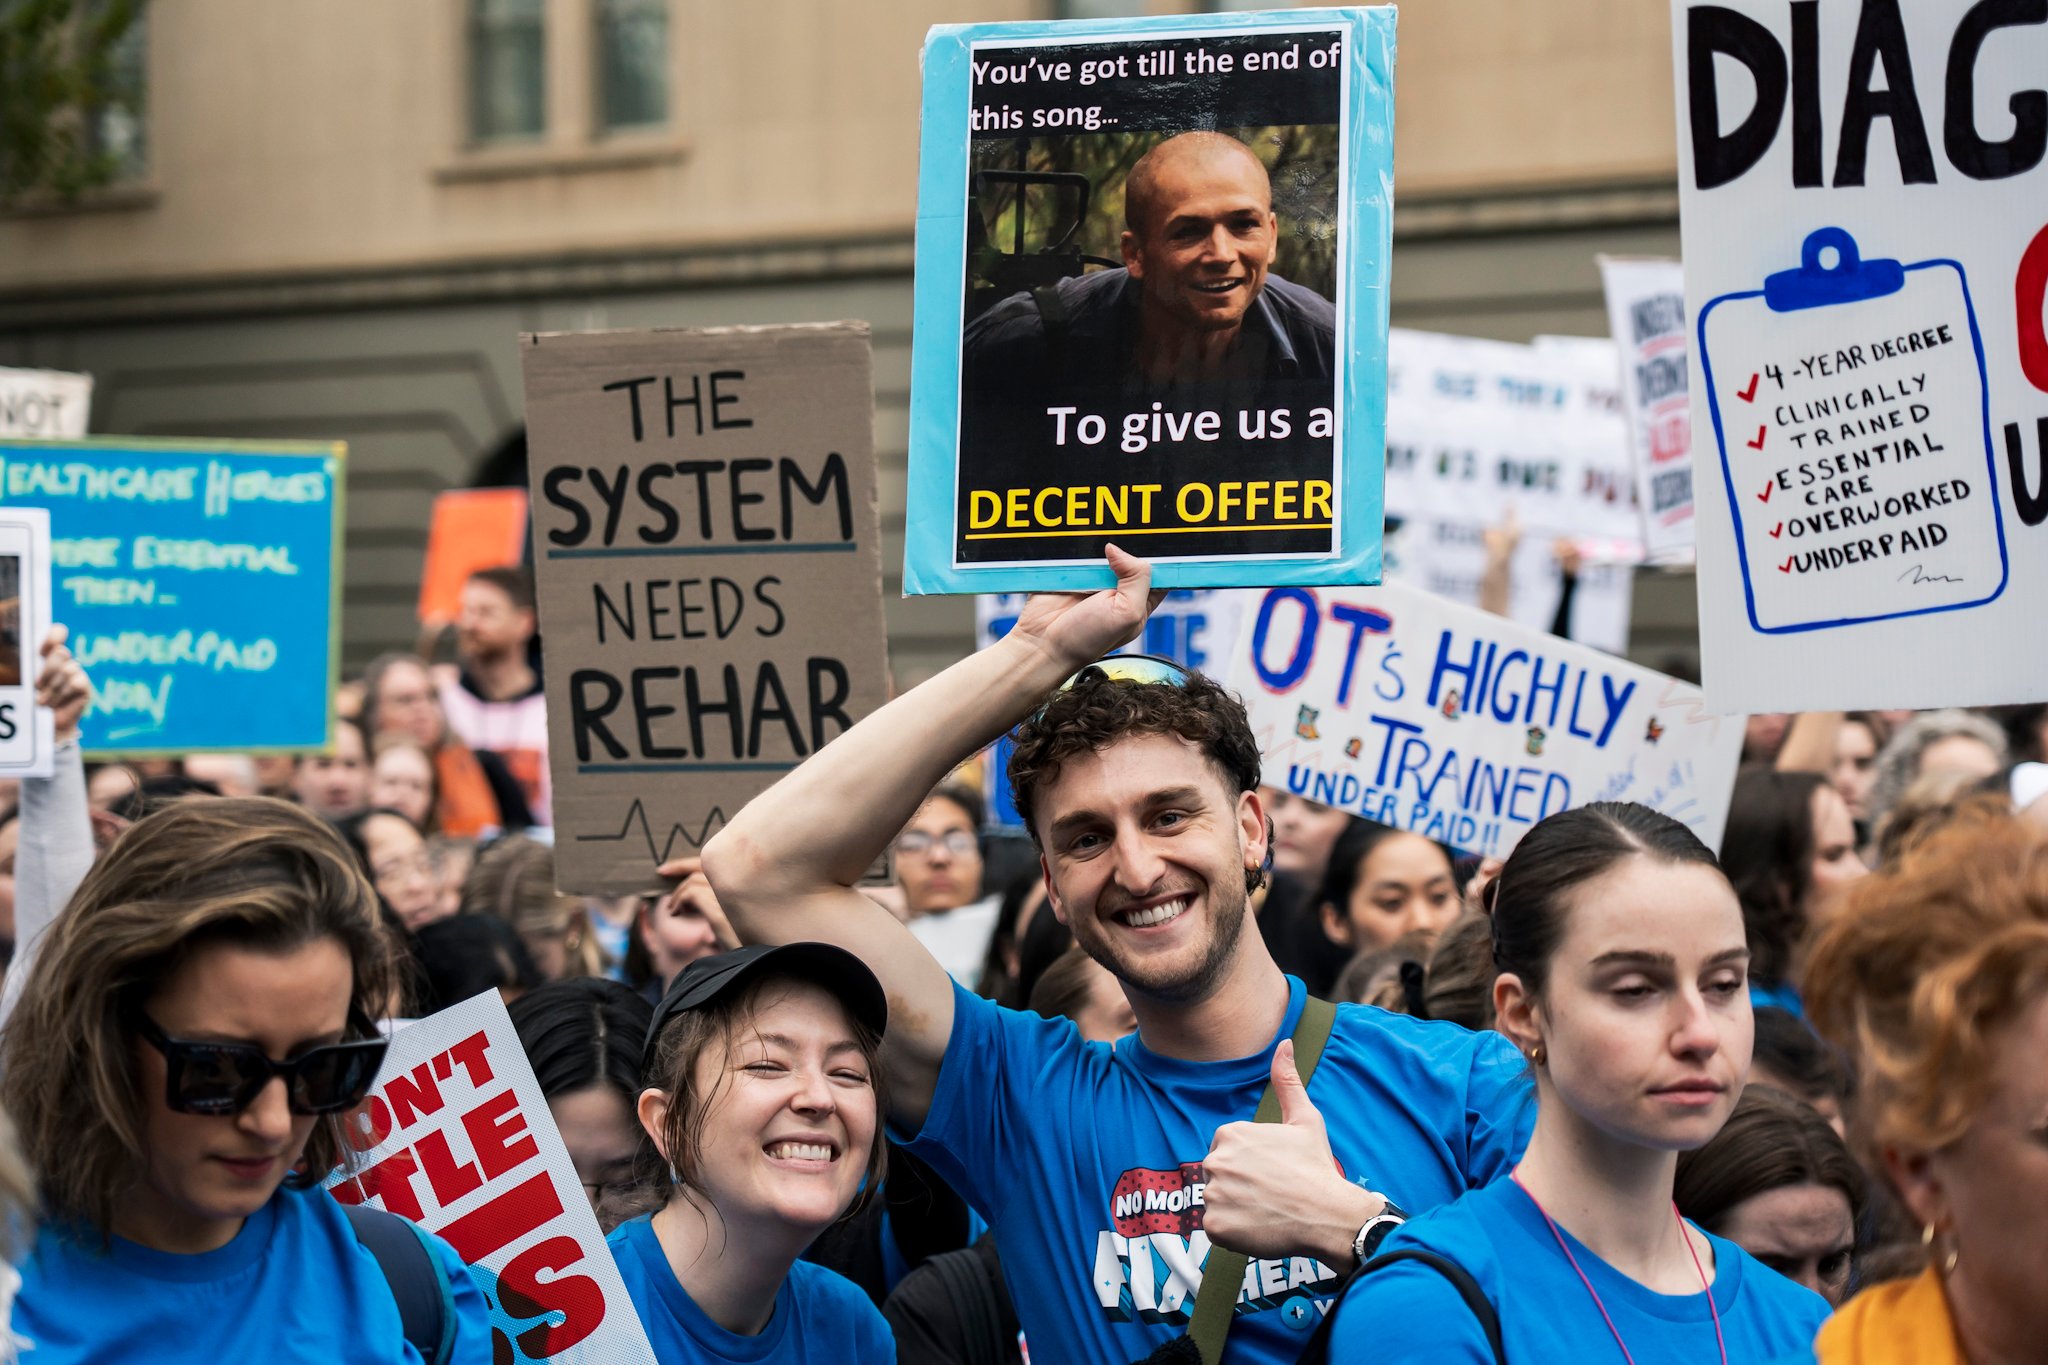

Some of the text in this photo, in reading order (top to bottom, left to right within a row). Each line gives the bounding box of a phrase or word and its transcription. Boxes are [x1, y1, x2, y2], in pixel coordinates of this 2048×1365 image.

[973, 41, 1342, 86] You've got till the end of
[970, 105, 1024, 131] this
[1870, 323, 1954, 362] DEGREE
[603, 370, 754, 442] THE
[1775, 372, 1927, 427] CLINICALLY
[1047, 402, 1333, 454] To give us a
[1790, 403, 1930, 450] TRAINED
[1775, 432, 1945, 491] ESSENTIAL
[542, 452, 854, 547] SYSTEM
[969, 479, 1333, 530] DECENT OFFER
[1788, 479, 1972, 538] OVERWORKED
[1804, 474, 1874, 506] CARE
[1793, 522, 1949, 574] UNDERPAID
[593, 576, 786, 644] NEEDS
[1425, 630, 1638, 749] HIGHLY
[1370, 714, 1572, 824] TRAINED
[1116, 1183, 1206, 1217] NO MORE
[1093, 1230, 1212, 1314] FIX
